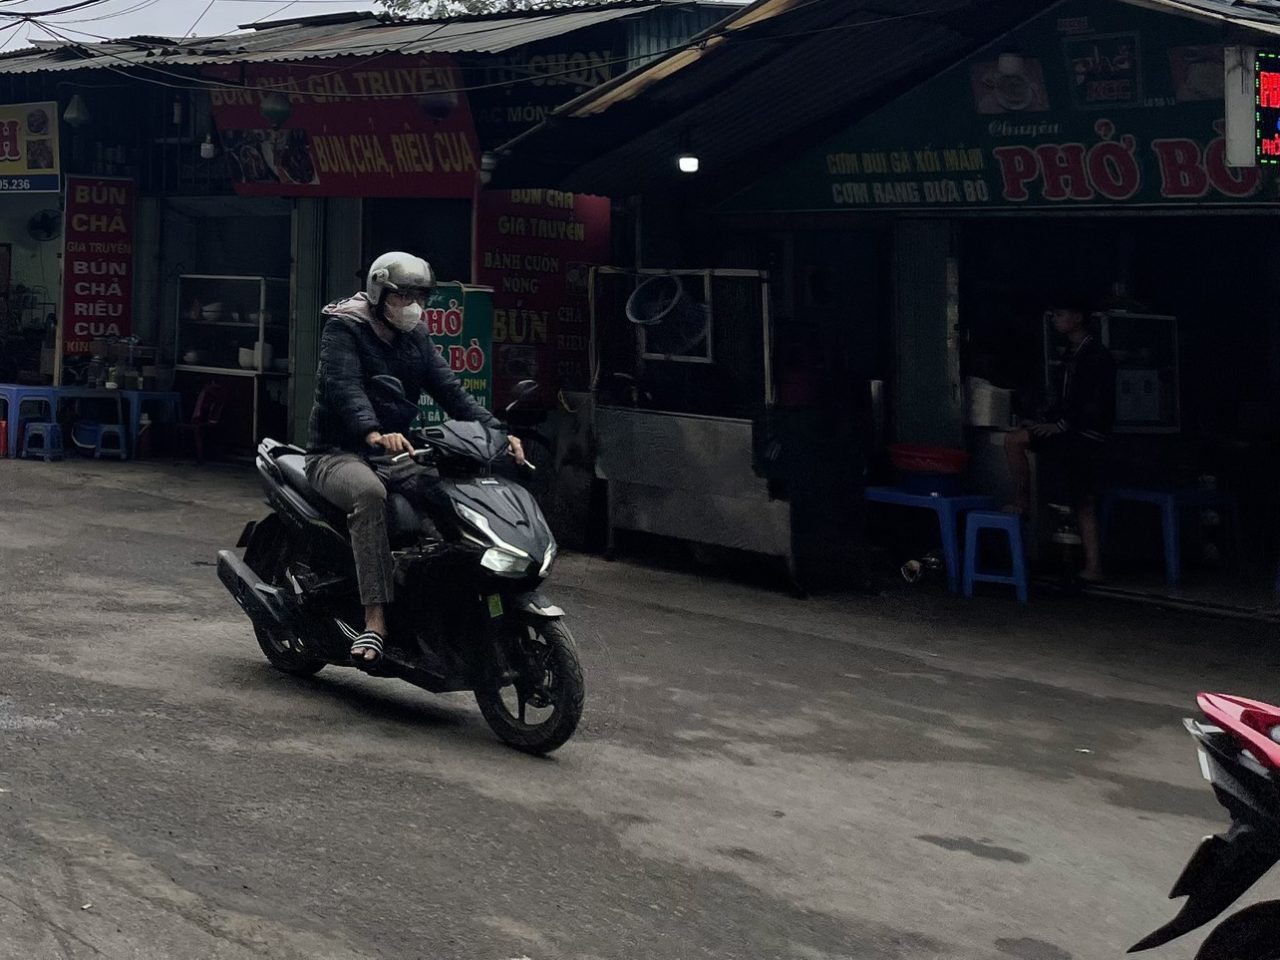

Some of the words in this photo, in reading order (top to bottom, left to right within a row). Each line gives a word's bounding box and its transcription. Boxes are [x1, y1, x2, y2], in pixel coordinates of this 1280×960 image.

[308, 74, 352, 103] GIA
[434, 131, 477, 173] CUA
[993, 118, 1141, 201] PHỞ
[1151, 119, 1263, 200] BÒ
[74, 181, 127, 206] BÚN
[872, 181, 921, 204] RANG
[72, 208, 128, 233] CHẢ
[66, 241, 87, 254] GIA
[483, 247, 522, 269] BÁNH
[73, 258, 127, 276] BÚN
[73, 277, 123, 297] CHẢ
[73, 299, 123, 317] RIÊU
[73, 321, 120, 336] CUA
[492, 299, 549, 344] BÚN
[448, 337, 485, 374] BÒ
